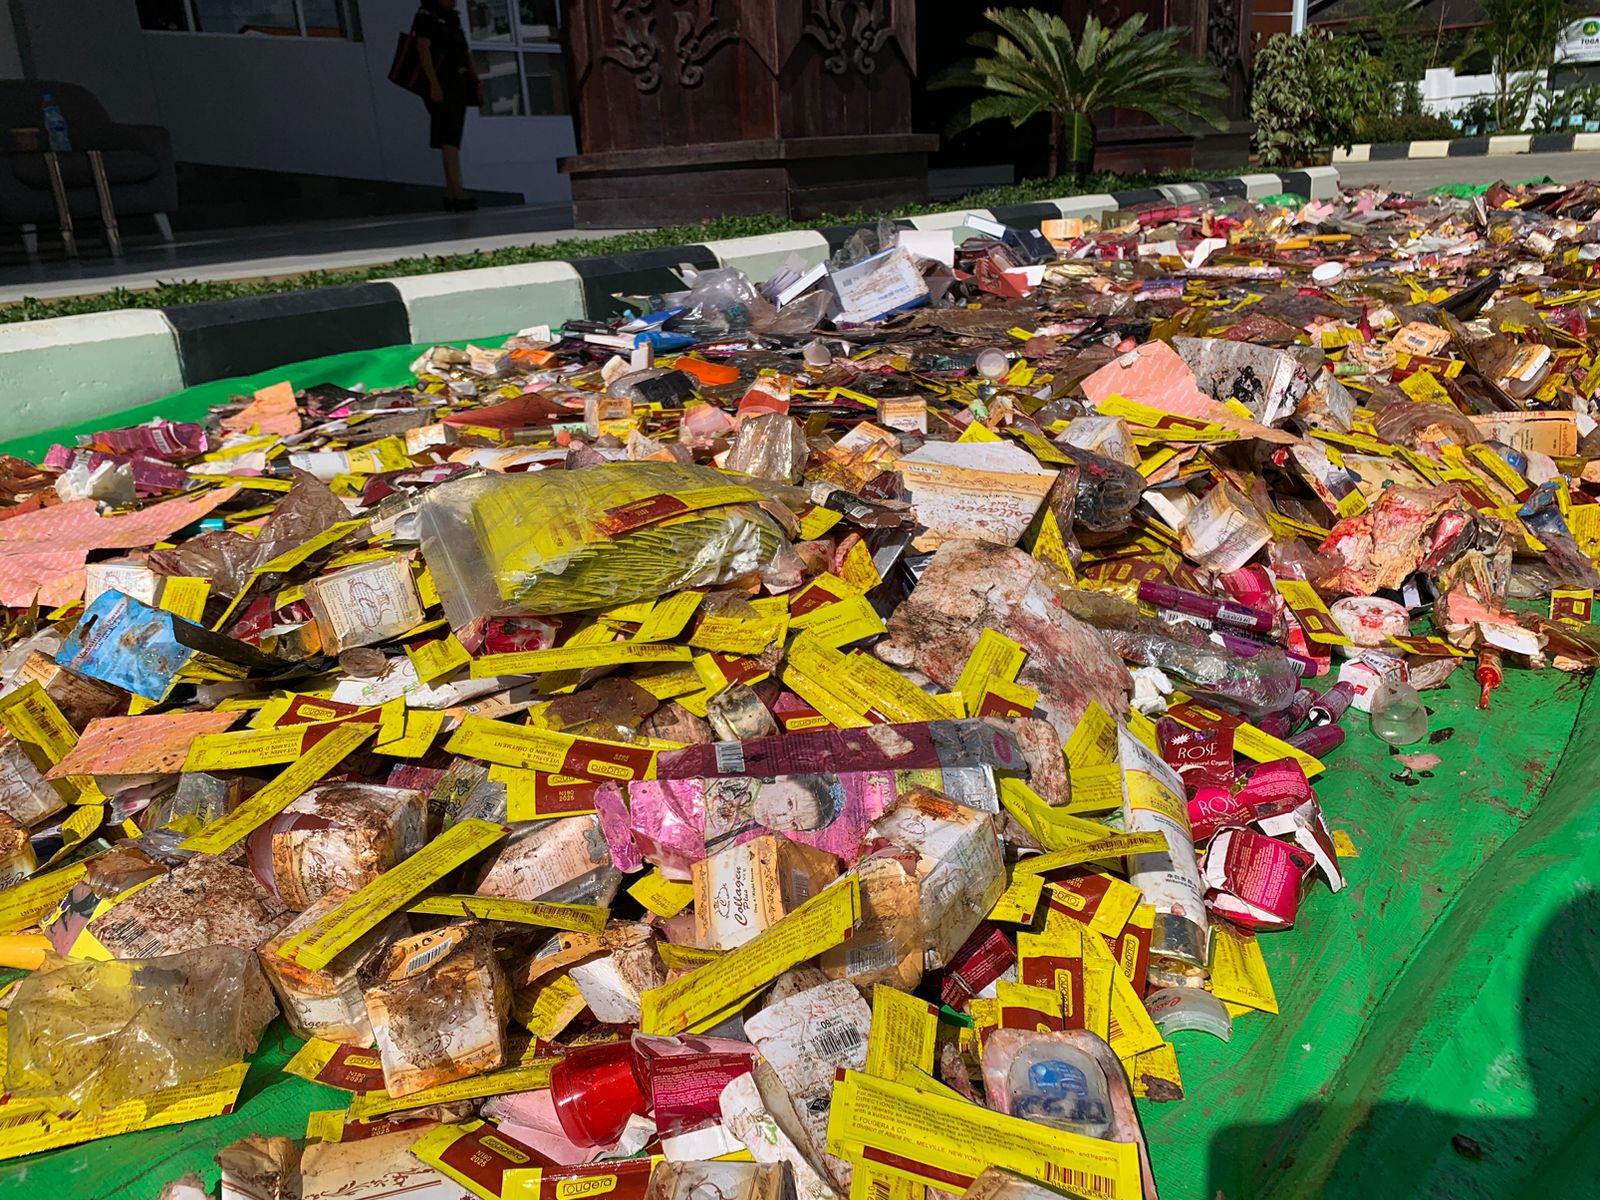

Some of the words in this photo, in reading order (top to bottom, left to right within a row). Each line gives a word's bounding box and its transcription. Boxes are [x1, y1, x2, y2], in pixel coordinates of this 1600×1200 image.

[953, 503, 1035, 525] Collagen
[1177, 743, 1217, 760] ROSE
[590, 762, 628, 777] fougera
[734, 864, 749, 926] Collagen
[1121, 938, 1136, 978] fougera
[469, 1153, 487, 1167] 2025
[562, 1176, 613, 1196] fougera
